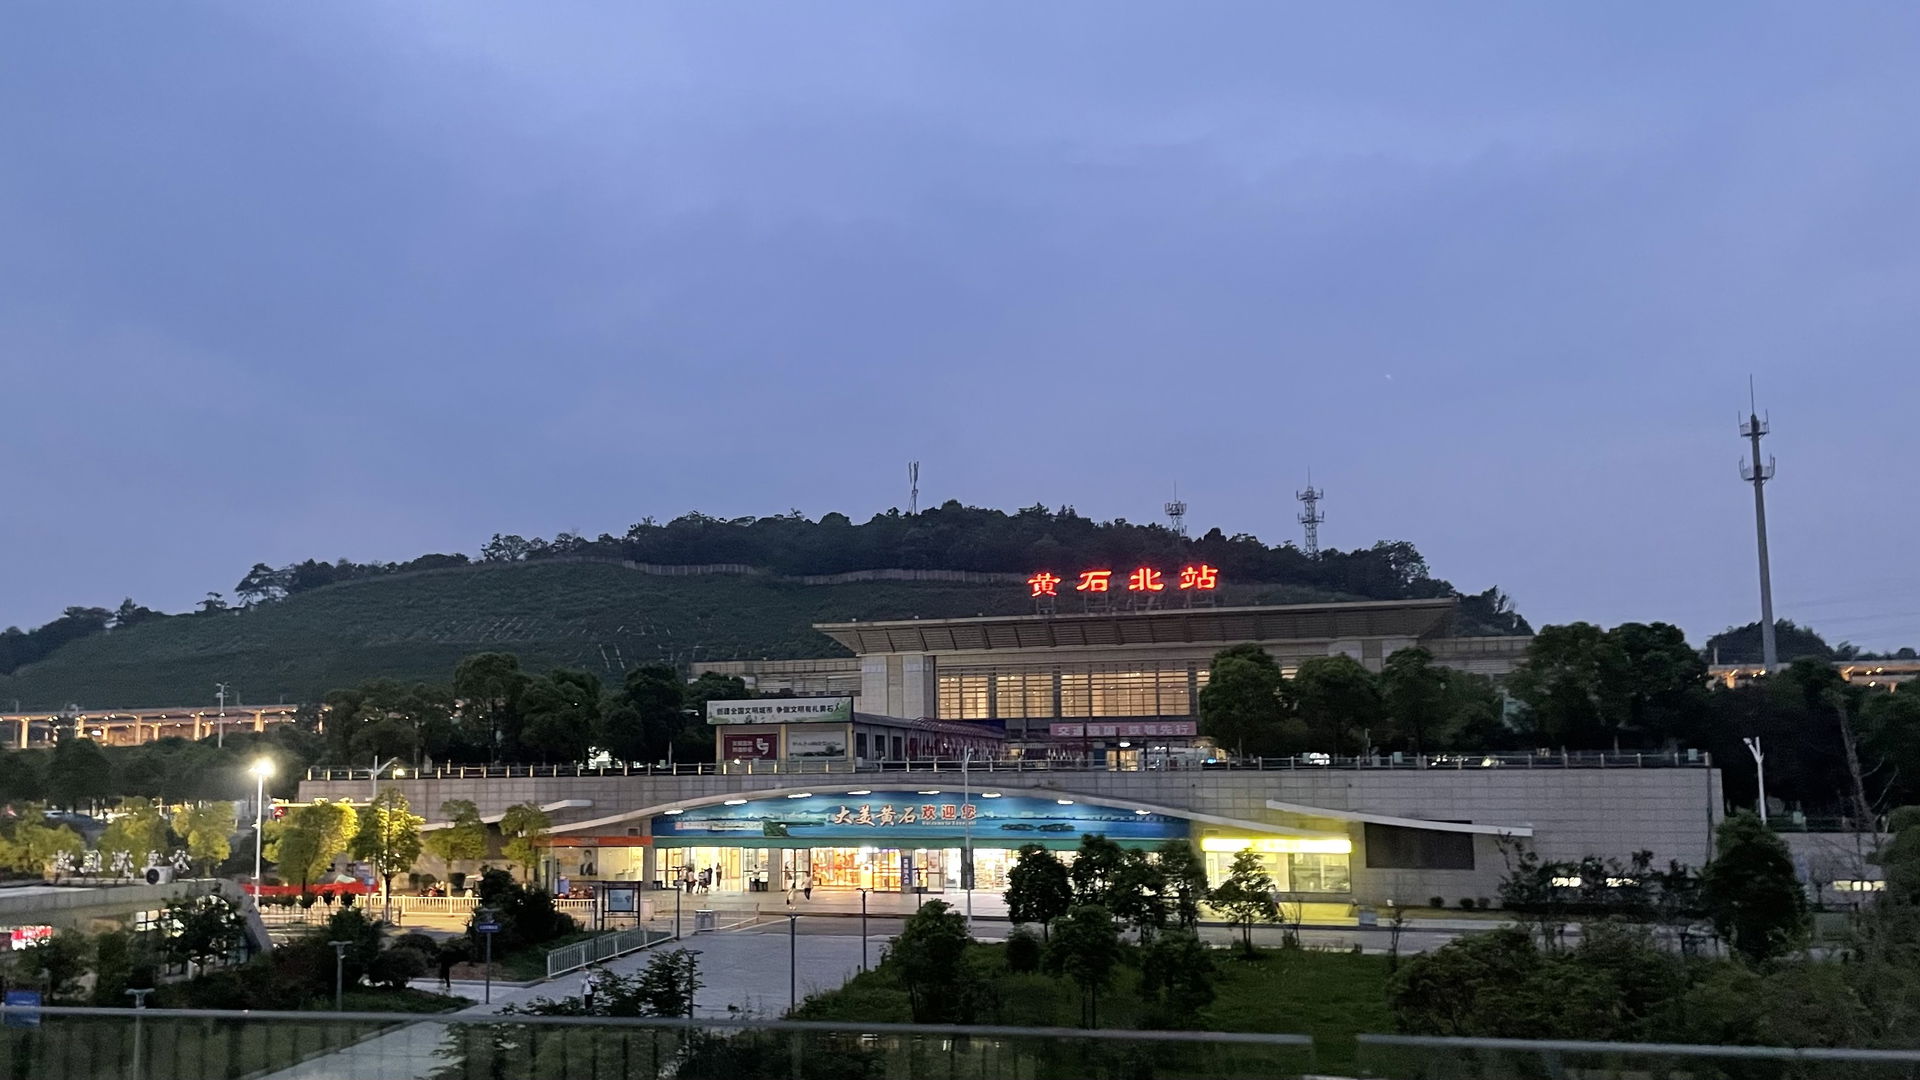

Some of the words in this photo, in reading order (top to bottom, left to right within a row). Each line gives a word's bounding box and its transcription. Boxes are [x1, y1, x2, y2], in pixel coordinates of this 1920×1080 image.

[1027, 564, 1219, 598] 黄石北站
[834, 804, 918, 827] 大美黄石
[921, 803, 977, 821] 欢迎您
